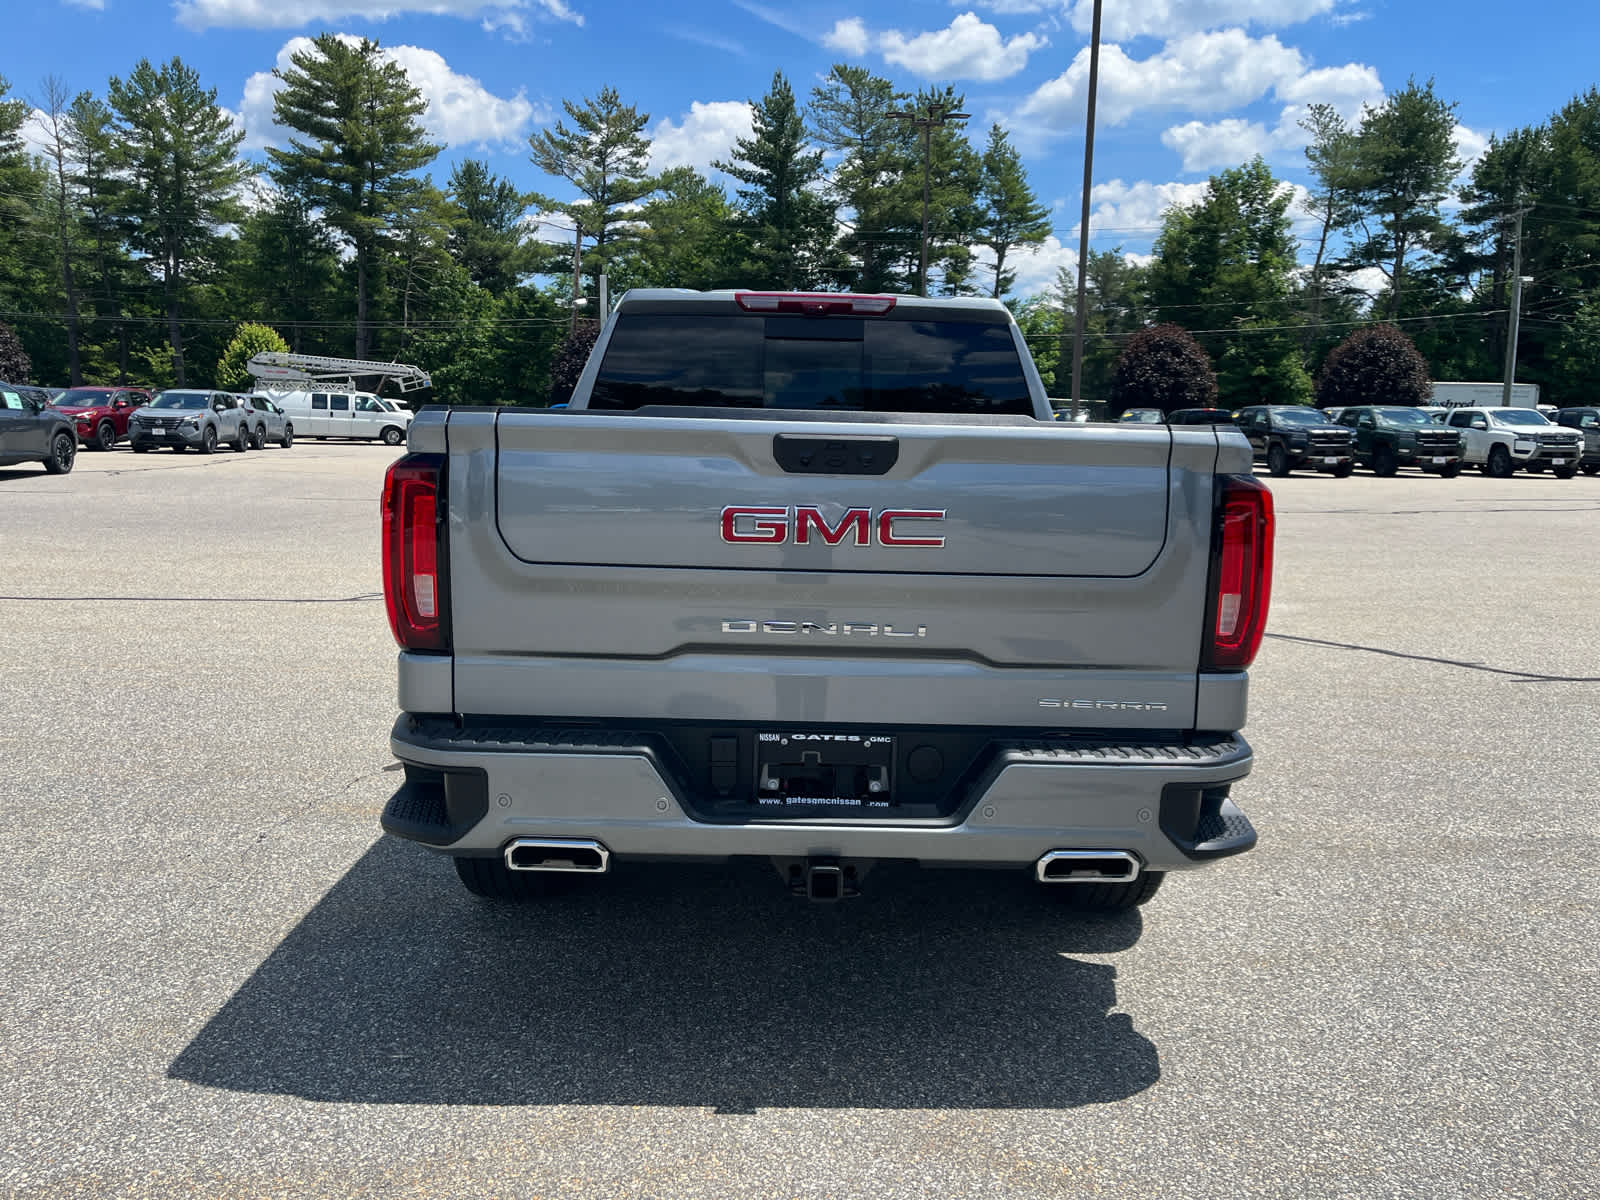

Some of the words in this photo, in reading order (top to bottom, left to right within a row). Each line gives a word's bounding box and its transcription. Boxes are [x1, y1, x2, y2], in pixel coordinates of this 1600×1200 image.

[720, 505, 947, 548] GMC
[721, 619, 927, 637] DENALI
[1038, 698, 1168, 711] SIERRA
[759, 733, 780, 741] NISSAN
